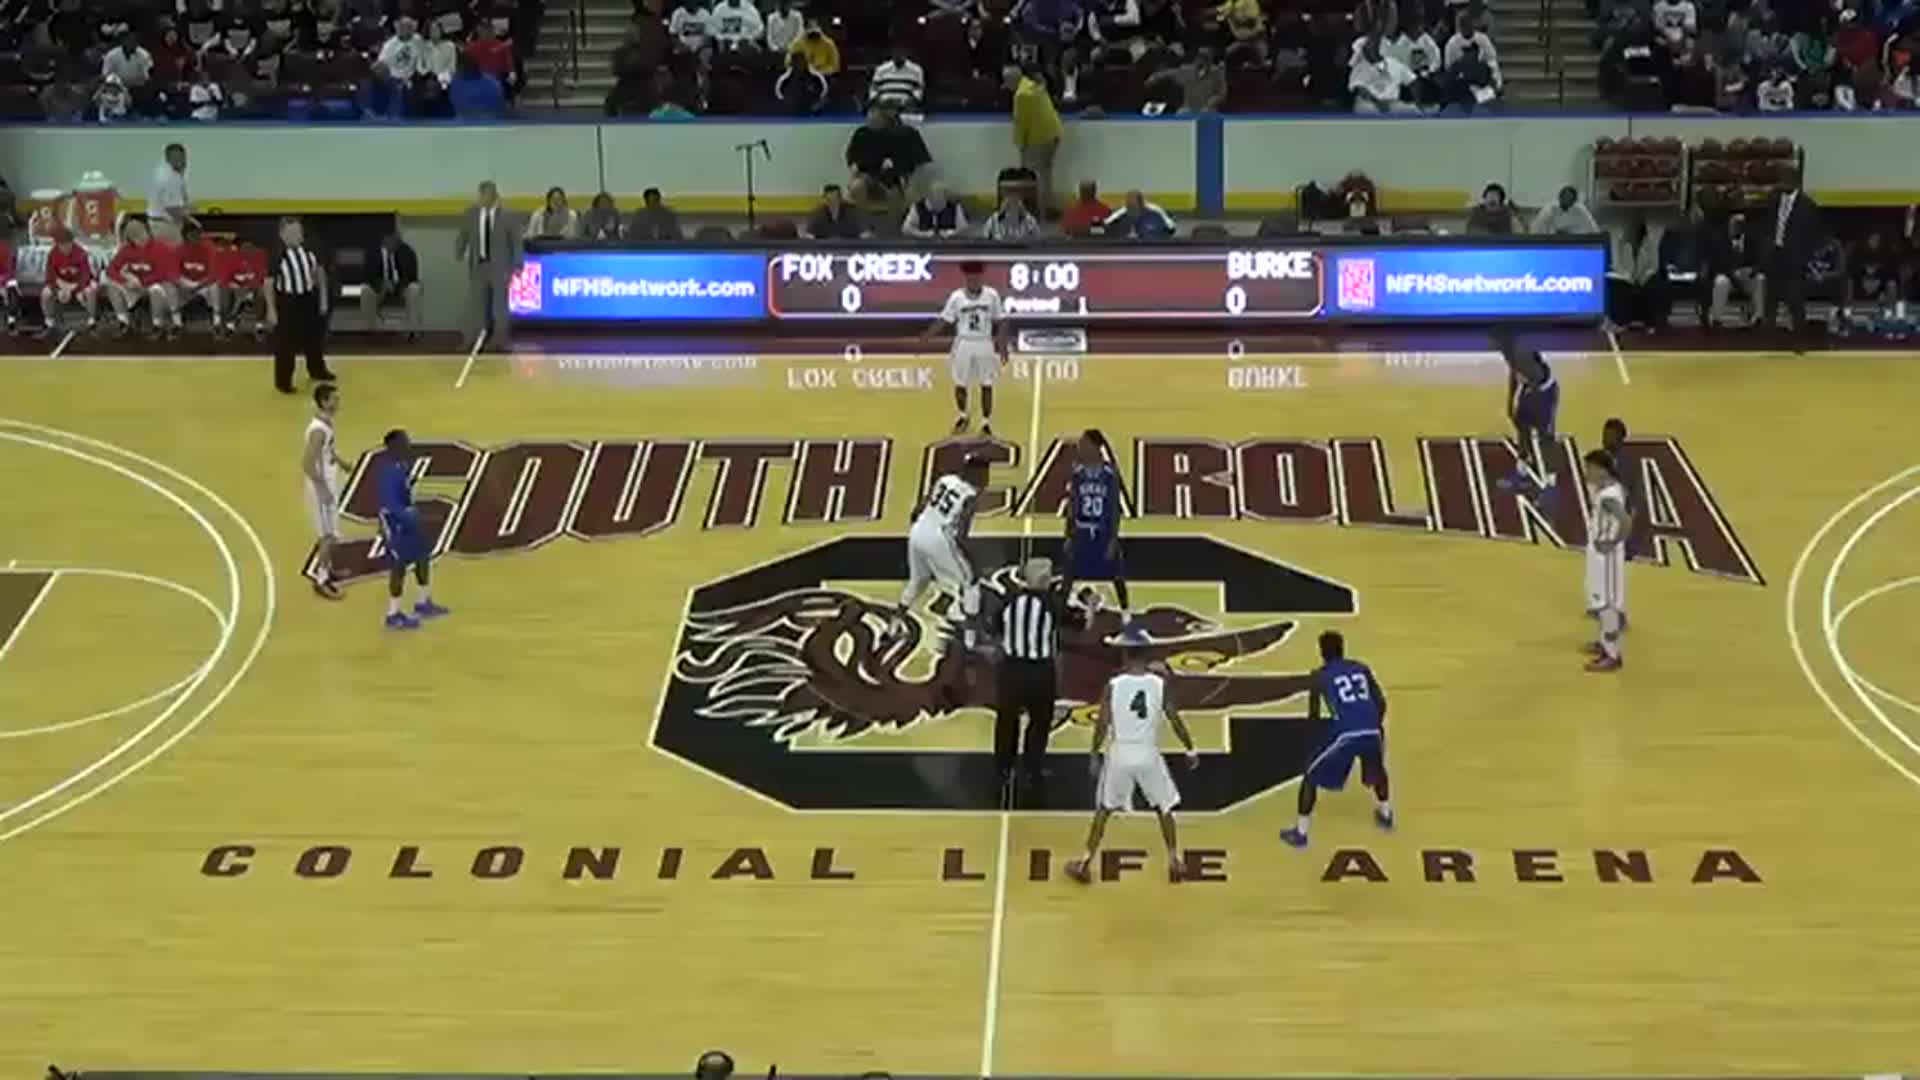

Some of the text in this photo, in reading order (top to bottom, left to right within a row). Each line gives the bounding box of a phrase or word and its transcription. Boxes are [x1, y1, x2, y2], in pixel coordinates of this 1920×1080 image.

[782, 254, 932, 281] FOX CREEK
[1010, 262, 1079, 291] 8:00
[1228, 251, 1312, 280] BURKE
[552, 277, 756, 299] NFHSnetwork.com
[1386, 272, 1592, 295] NFHSnetwork.com
[842, 288, 861, 313] 0
[1226, 287, 1246, 314] 0
[302, 436, 1766, 585] SOUTH CAROLINA
[1082, 496, 1103, 517] 20
[1333, 673, 1370, 702] 23
[1129, 689, 1148, 719] 4
[200, 844, 1761, 884] COLONIAL LIFE ARENA
